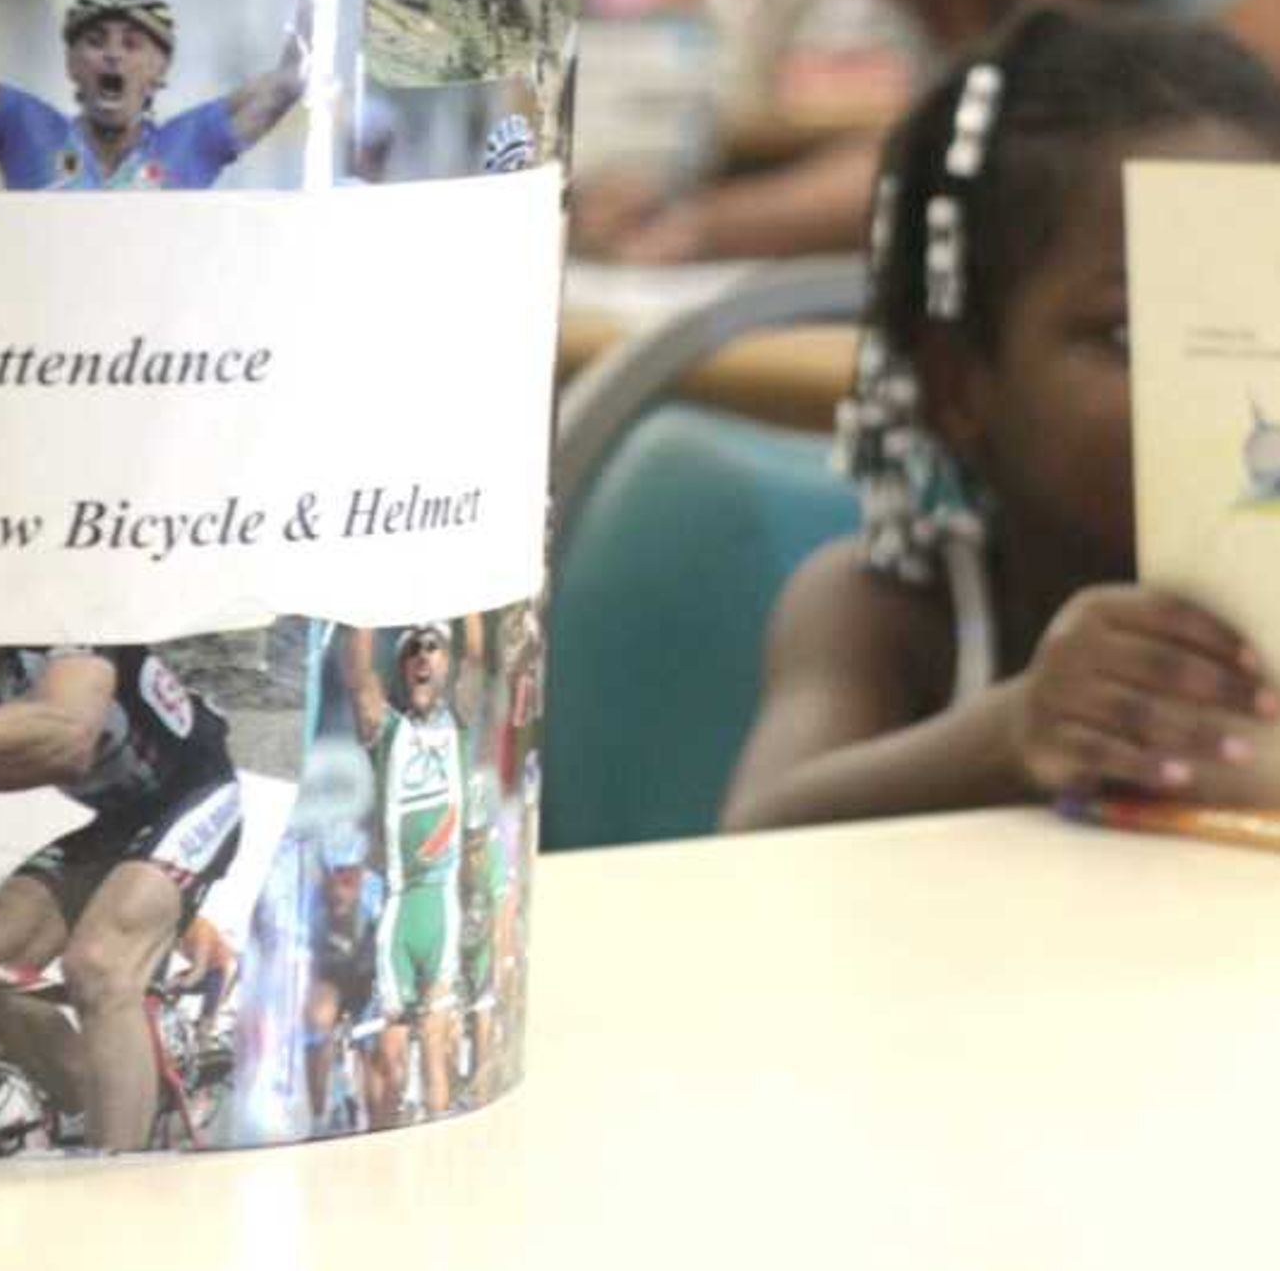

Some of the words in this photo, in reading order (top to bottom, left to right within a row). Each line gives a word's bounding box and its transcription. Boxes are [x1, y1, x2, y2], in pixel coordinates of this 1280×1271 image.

[64, 497, 266, 563] Bicycle
[282, 492, 322, 544] &
[341, 484, 481, 539] Helmet
